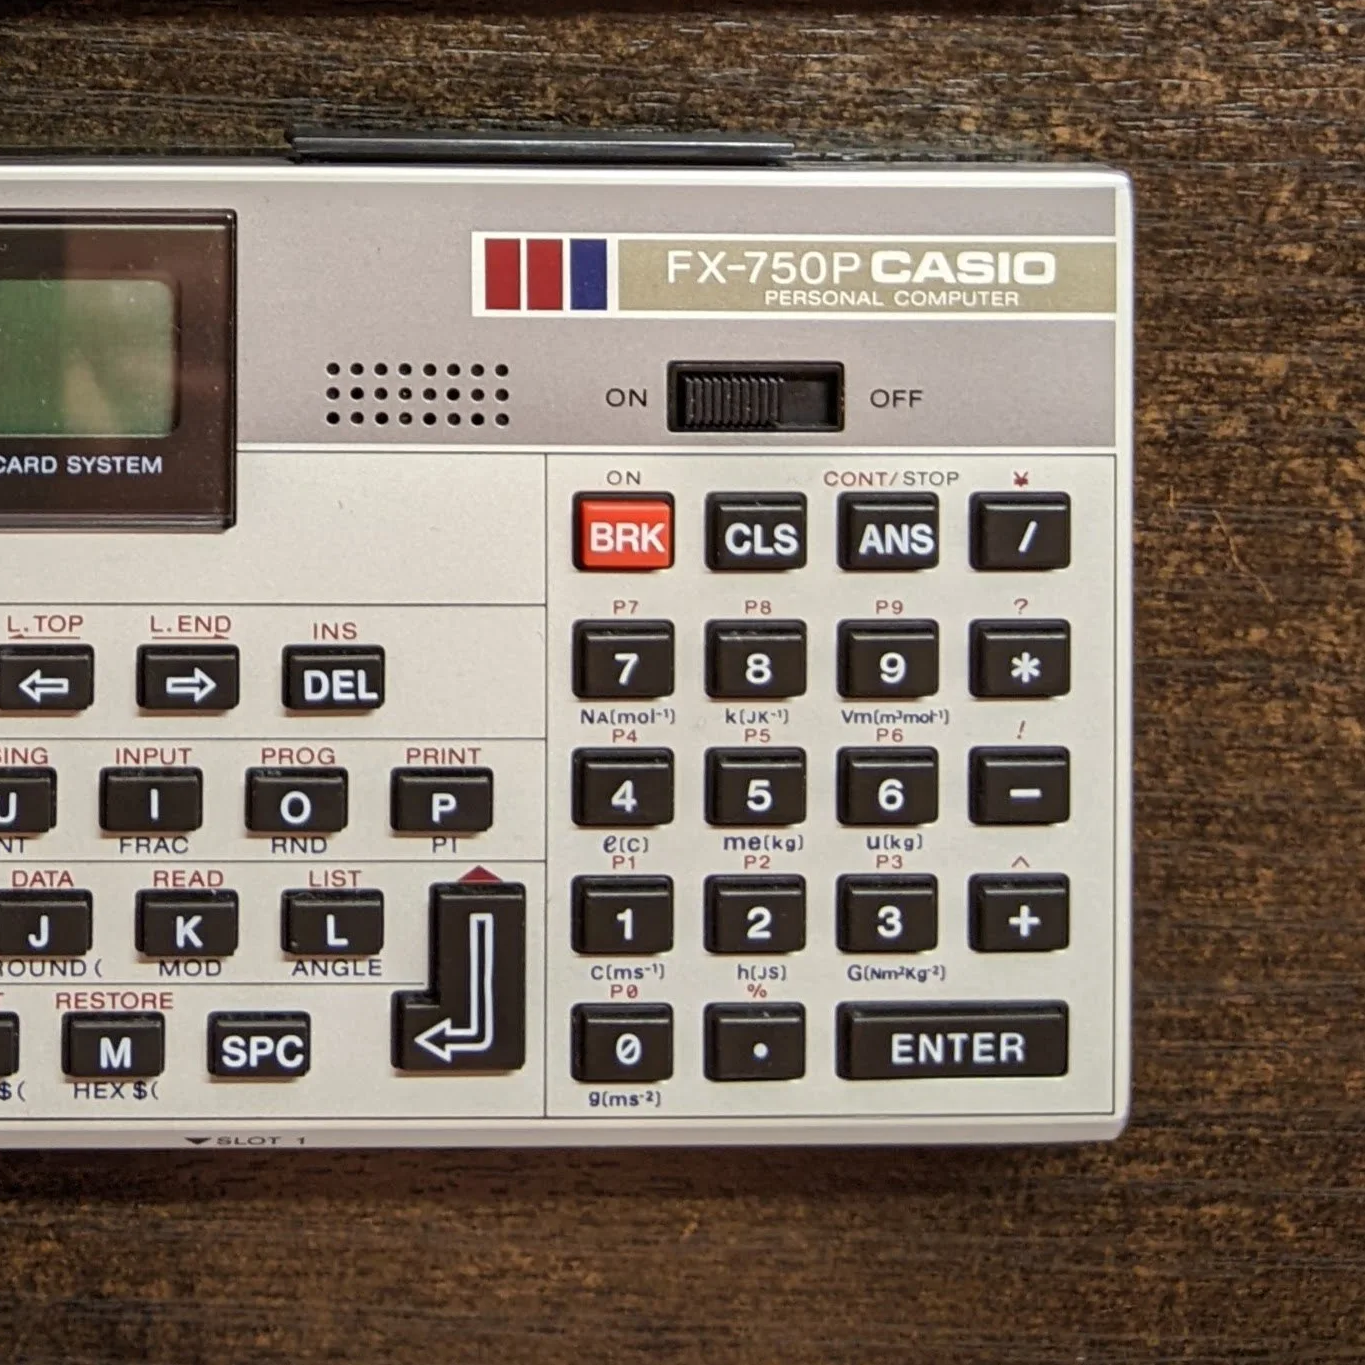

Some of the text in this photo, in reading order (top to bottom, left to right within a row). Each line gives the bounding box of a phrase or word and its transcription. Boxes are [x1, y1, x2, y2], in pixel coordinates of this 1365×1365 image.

[667, 250, 1056, 284] FX-750P CASIO
[765, 290, 1019, 306] PERSONAL COMPUTER
[605, 388, 647, 408] ON
[869, 388, 924, 409] OFF
[66, 455, 162, 474] SYSTEM
[606, 470, 641, 485] ON
[589, 523, 664, 552] BRK
[724, 523, 798, 555] CLS
[859, 524, 934, 554] ANS
[613, 601, 638, 615] P7
[745, 601, 771, 615] P8
[876, 601, 903, 615] P9
[314, 623, 358, 641] INS
[613, 653, 639, 684] 7
[745, 653, 772, 684] 8
[879, 652, 906, 683] 9
[303, 669, 378, 701] DEL
[612, 729, 637, 743] P4
[745, 729, 770, 742] P5
[876, 728, 903, 742] P6
[116, 748, 192, 765] INPUT
[262, 747, 336, 765] PROG
[406, 748, 482, 765] PRINT
[150, 787, 159, 819] I
[611, 779, 637, 813] 4
[747, 778, 772, 812] 5
[878, 778, 904, 811] 6
[432, 793, 457, 822] P
[119, 837, 189, 854] FRAC
[272, 837, 328, 853] RND
[433, 837, 458, 853] PI
[612, 855, 636, 869] P1
[745, 855, 770, 869] P2
[876, 855, 903, 869] P3
[11, 870, 74, 887] DATA
[152, 870, 224, 887] READ
[309, 870, 362, 887] LIST
[616, 908, 633, 941] 1
[747, 906, 772, 939] 2
[877, 905, 903, 938] 3
[28, 915, 49, 948] J
[176, 915, 204, 948] K
[326, 915, 349, 947] L
[159, 959, 222, 977] MOD
[291, 959, 382, 977] ANGLE
[56, 992, 174, 1010] RESTORE
[100, 1037, 132, 1069] M
[221, 1035, 304, 1069] SPC
[891, 1032, 1025, 1064] ENTER
[216, 1136, 282, 1146] SLOT
